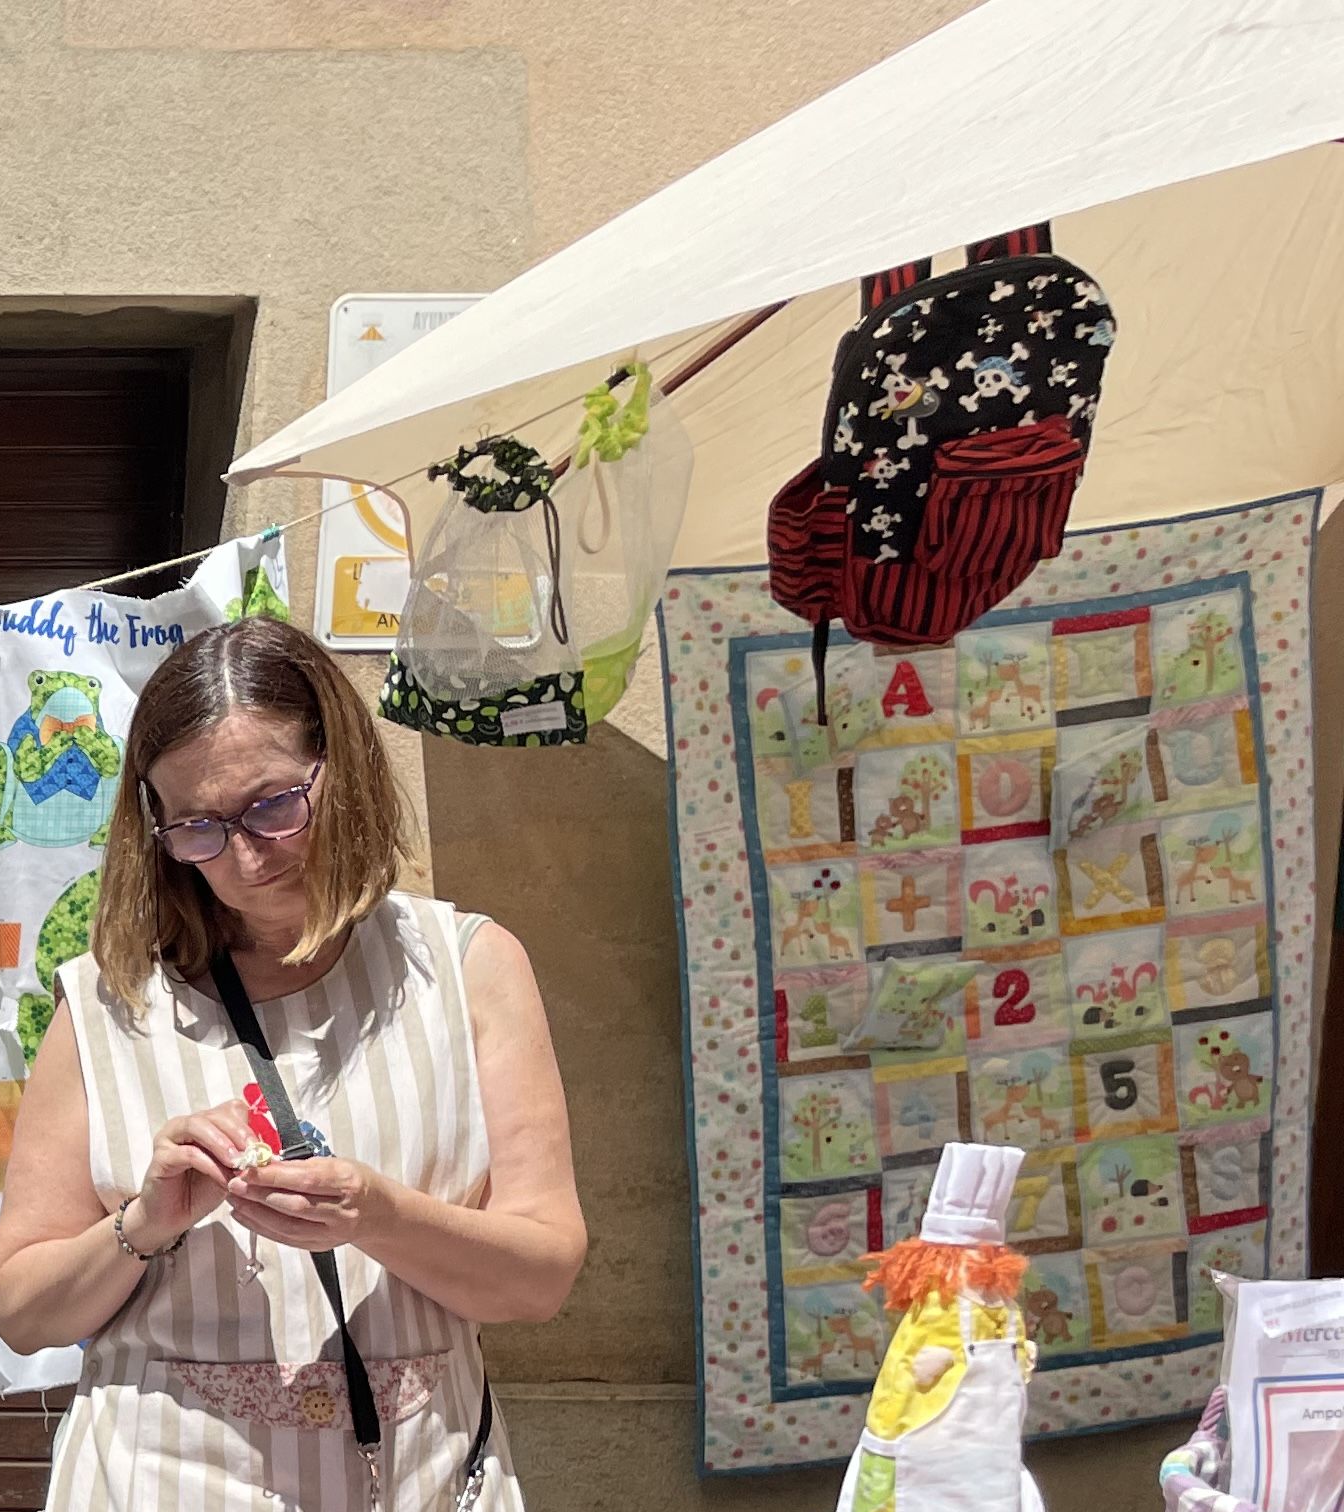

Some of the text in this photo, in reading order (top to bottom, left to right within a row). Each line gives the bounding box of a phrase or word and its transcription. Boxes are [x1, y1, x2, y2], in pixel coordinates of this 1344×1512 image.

[85, 602, 121, 645] the
[992, 968, 1036, 1026] 2
[1099, 1059, 1138, 1111] 5
